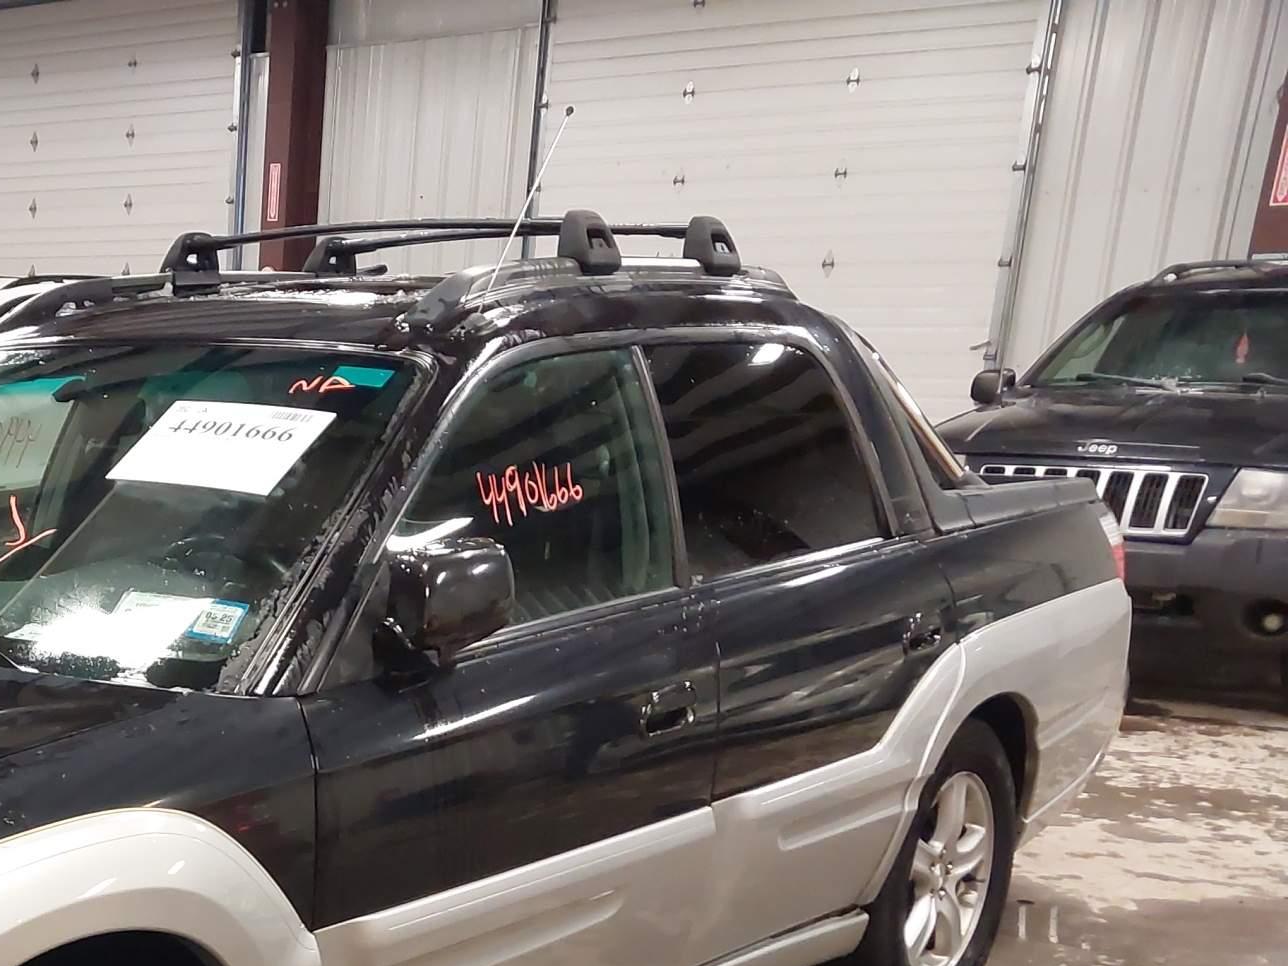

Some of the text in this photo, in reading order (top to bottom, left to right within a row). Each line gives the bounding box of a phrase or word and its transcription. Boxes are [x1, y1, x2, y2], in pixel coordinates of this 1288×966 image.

[168, 418, 297, 442] 44901666
[1077, 440, 1118, 455] Jeep
[476, 460, 583, 527] 44901666
